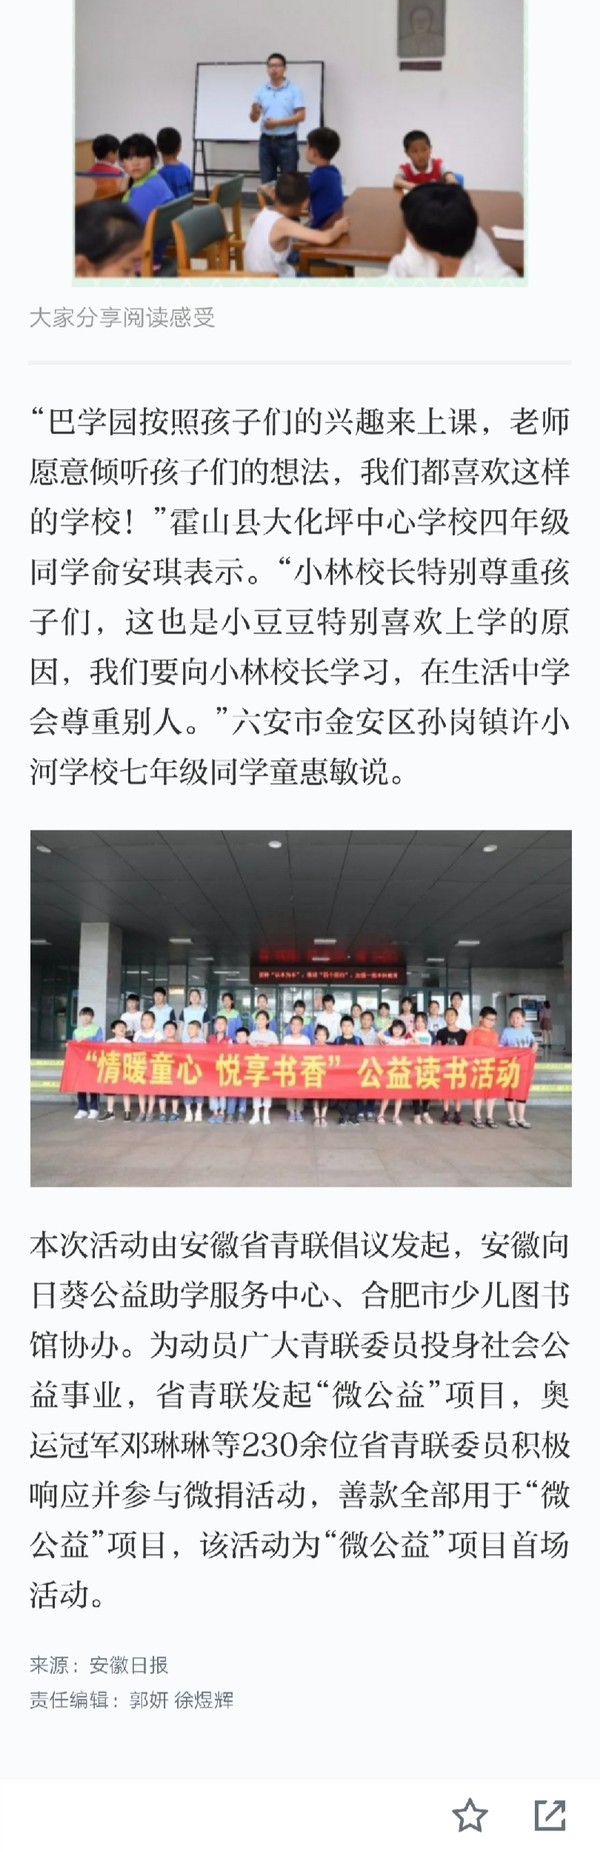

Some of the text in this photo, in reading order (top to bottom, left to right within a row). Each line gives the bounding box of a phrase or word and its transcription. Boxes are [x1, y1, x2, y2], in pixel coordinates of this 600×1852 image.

[30, 307, 215, 328] 大家分享阅读感受
[29, 457, 570, 485] 愿意倾听孩子们的想法，我们都喜欢这样
[31, 507, 570, 536] 的学校！”霍山县大化坪中心学校四年级
[30, 607, 570, 636] 子们，这也是小豆豆特别喜欢上学的原
[31, 657, 570, 685] 因，我们要向小林校长学习，在生活中学
[30, 707, 569, 736] 会尊重别人。”六安市金安区孙岗镇许小
[30, 757, 401, 785] 河学校七年级同学童惠敏说。
[85, 1051, 521, 1090] “情暖童心 悦享书香” 公益读书活动
[30, 1230, 568, 1259] 本次活动由安徽省青联倡议发起，安徽向
[34, 1280, 569, 1309] 日葵公益助学服务中心、合肥市少儿图书
[30, 1330, 570, 1359] 馆协办。为动员广大青联委员投身社会公
[30, 1430, 570, 1459] 运冠军邓琳琳等230余位省青联委员积极
[30, 1580, 101, 1609] 活动。
[30, 1655, 168, 1674] 来源：安徽日报
[30, 1691, 233, 1709] 责任编辑：郭妍 徐煜辉
